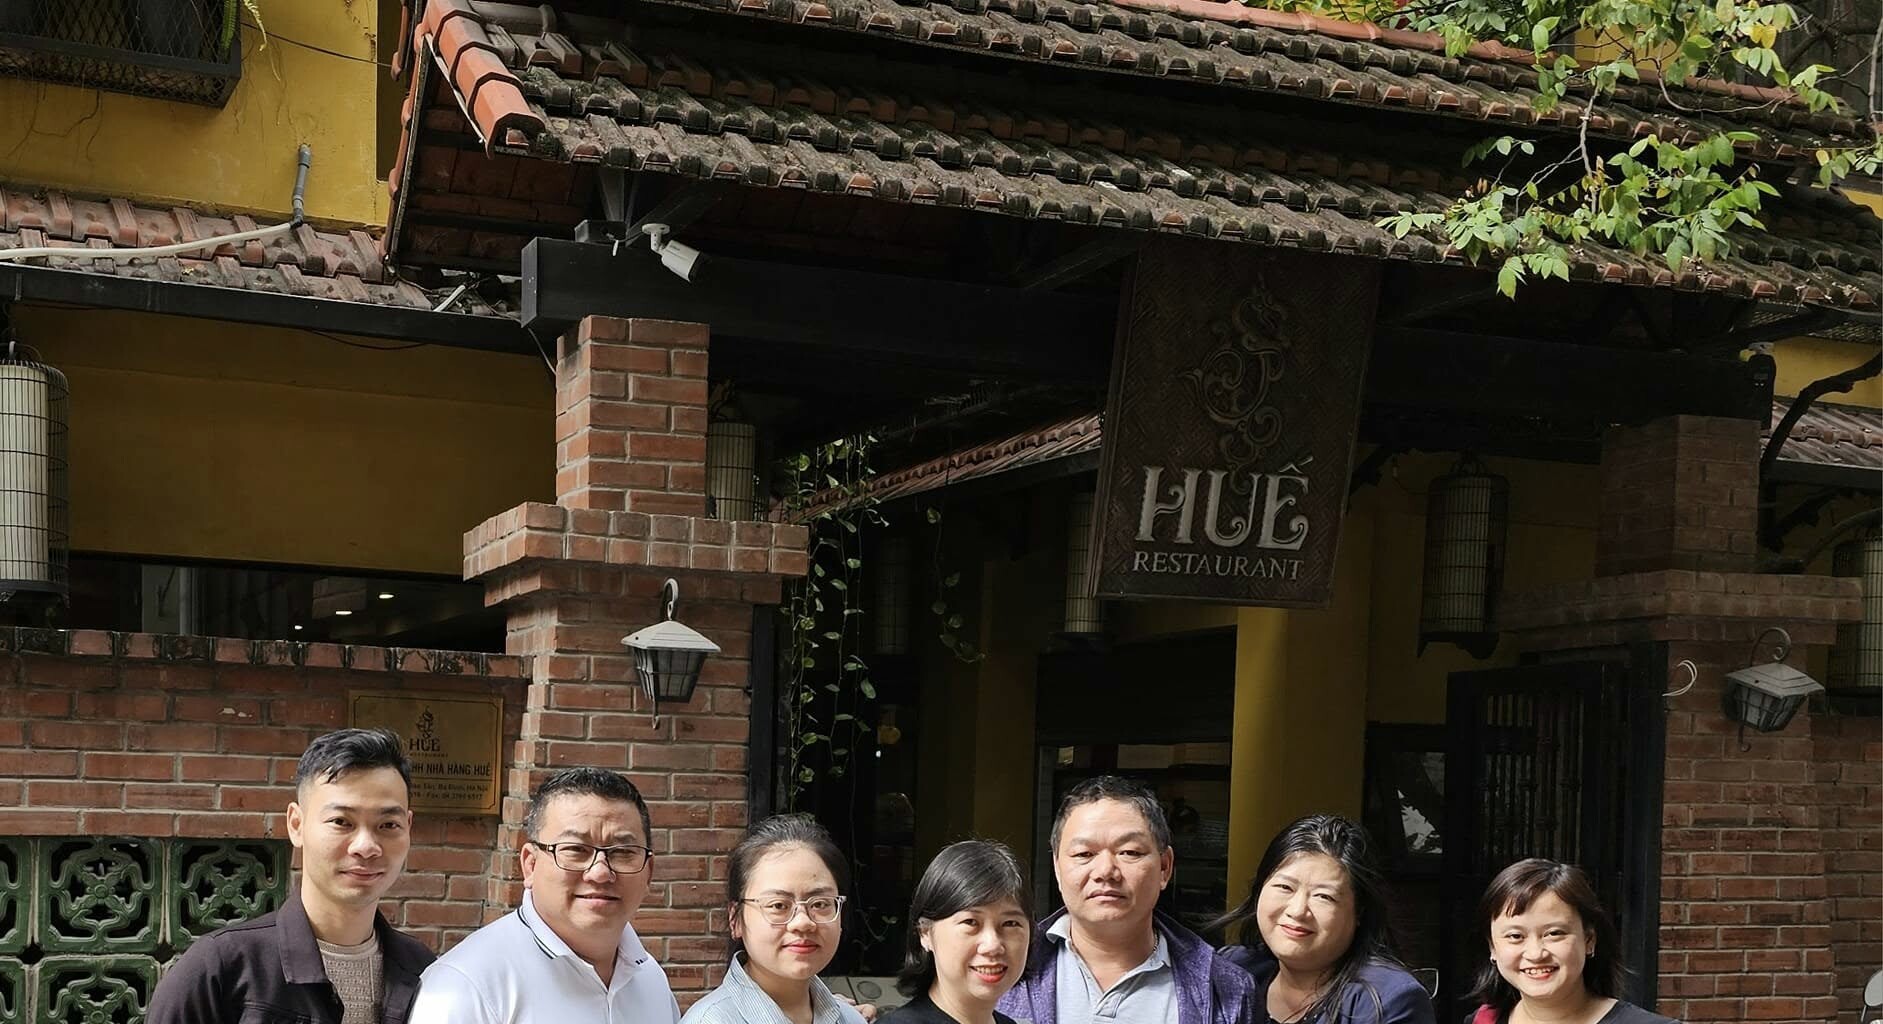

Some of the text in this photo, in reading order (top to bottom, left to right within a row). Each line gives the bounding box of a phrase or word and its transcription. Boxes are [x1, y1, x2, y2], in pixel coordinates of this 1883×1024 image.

[1134, 455, 1314, 551] HUẾ
[1132, 550, 1304, 580] RESTAURANT
[448, 762, 471, 776] HÀNG
